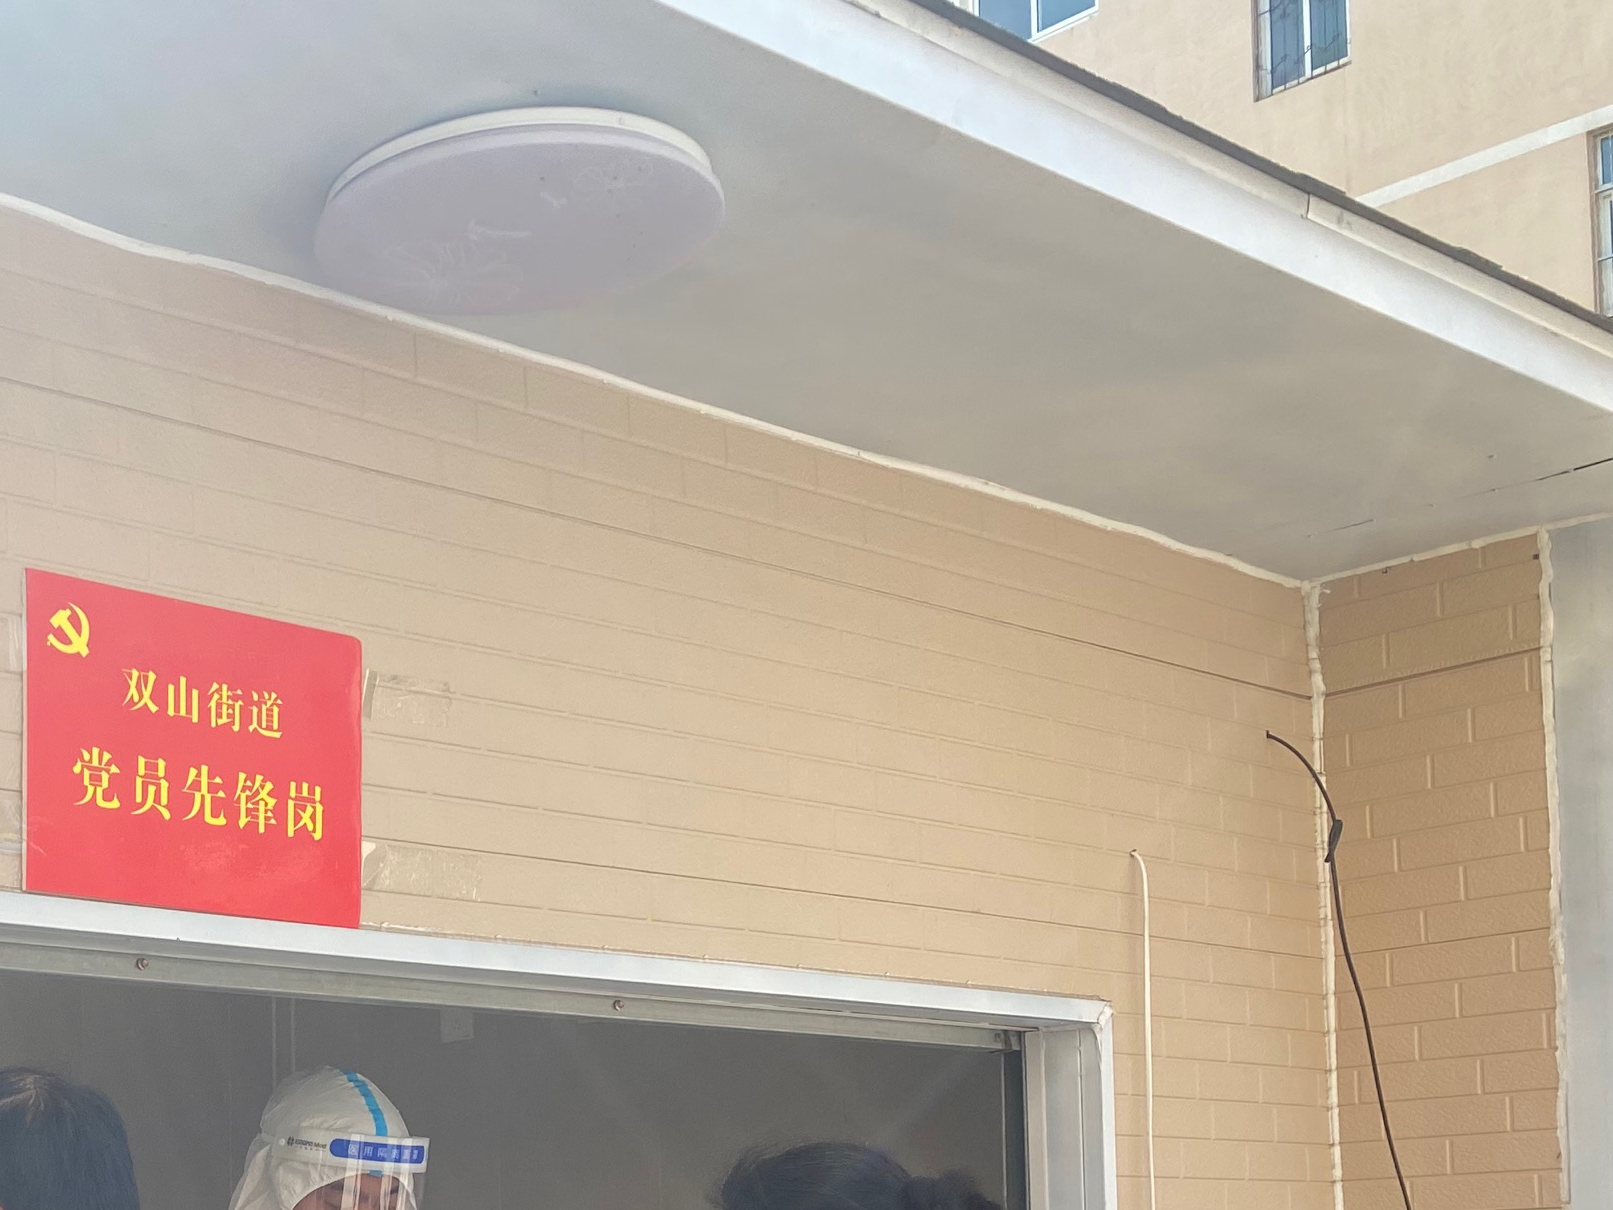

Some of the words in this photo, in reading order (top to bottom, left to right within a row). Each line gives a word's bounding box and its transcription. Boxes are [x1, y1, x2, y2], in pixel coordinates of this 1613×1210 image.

[122, 667, 284, 739] 双山街道
[72, 746, 325, 841] 党员先锋岗
